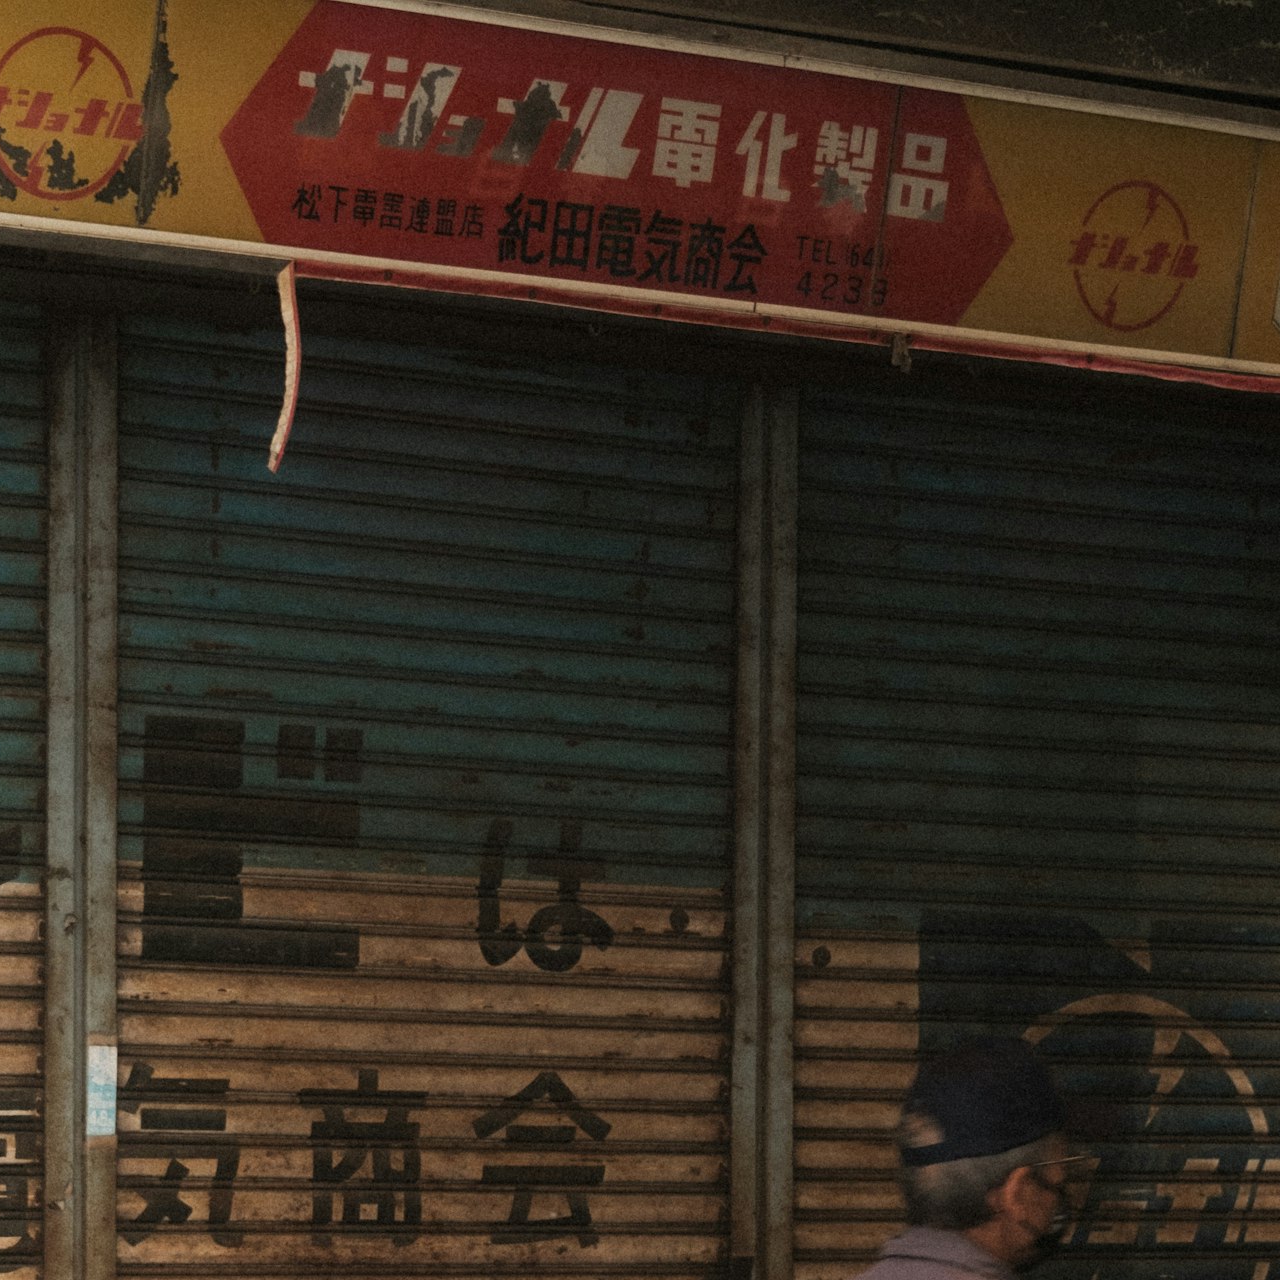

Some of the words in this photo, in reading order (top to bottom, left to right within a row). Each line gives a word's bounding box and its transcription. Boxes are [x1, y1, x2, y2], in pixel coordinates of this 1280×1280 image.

[1068, 232, 1199, 279] ナショナル
